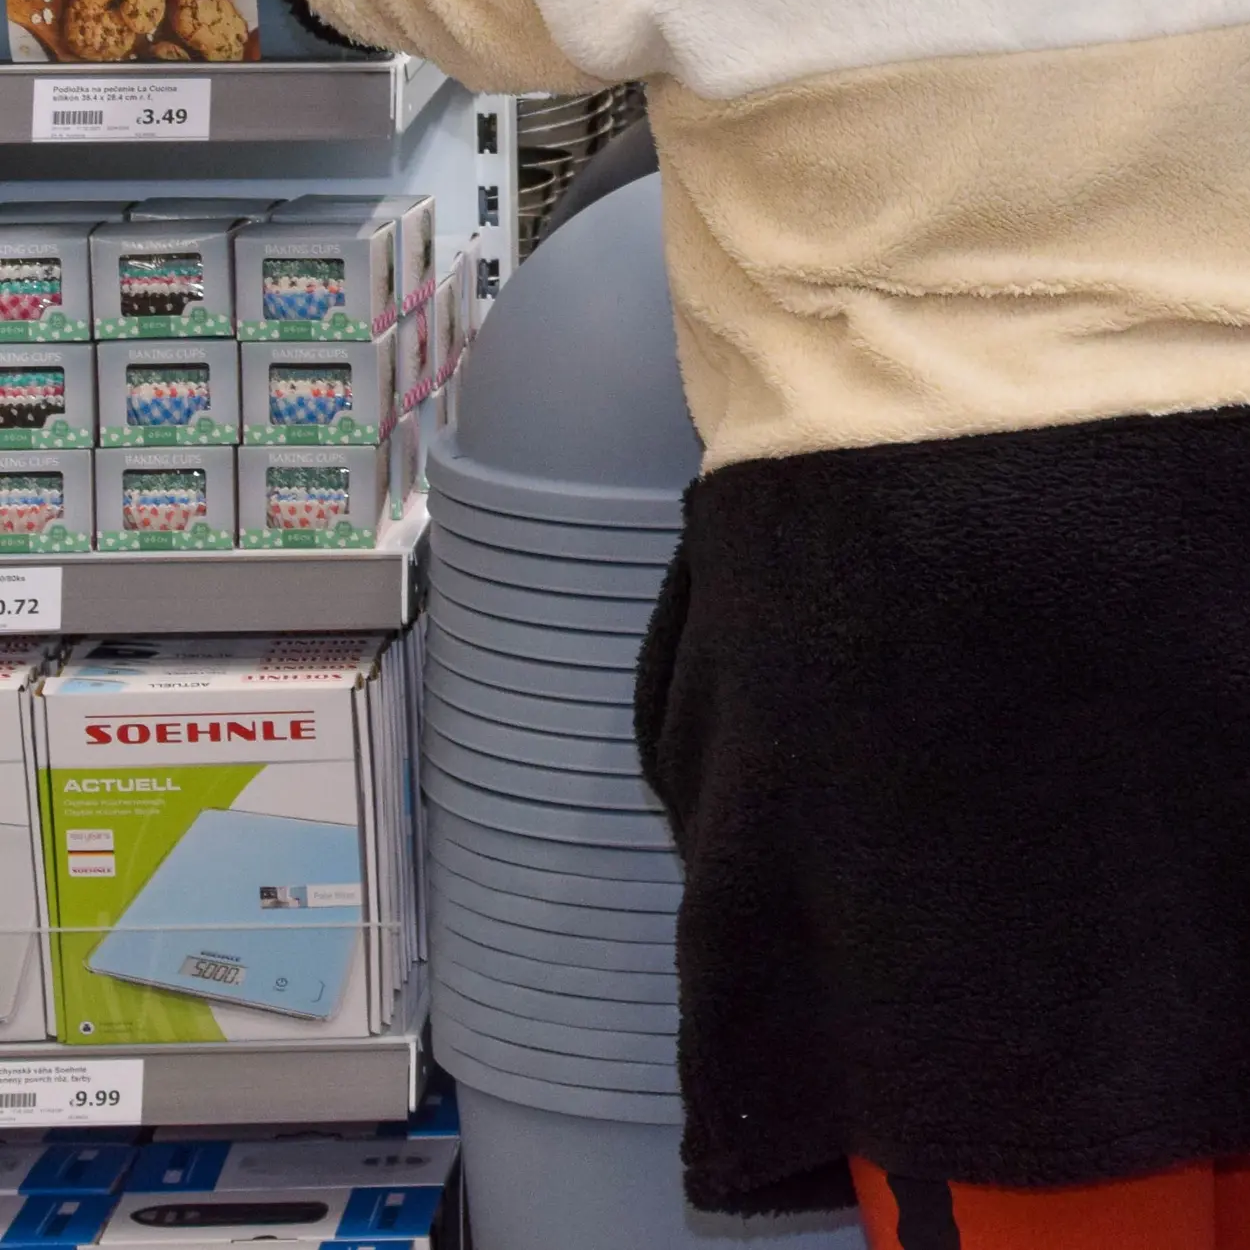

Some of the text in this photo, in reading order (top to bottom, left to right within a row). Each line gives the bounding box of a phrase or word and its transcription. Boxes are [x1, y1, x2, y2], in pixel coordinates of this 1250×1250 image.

[103, 85, 135, 94] pečenie
[85, 720, 317, 745] SOEHNLE
[64, 778, 182, 793] ACTUELL
[55, 1066, 87, 1074] Soehnle
